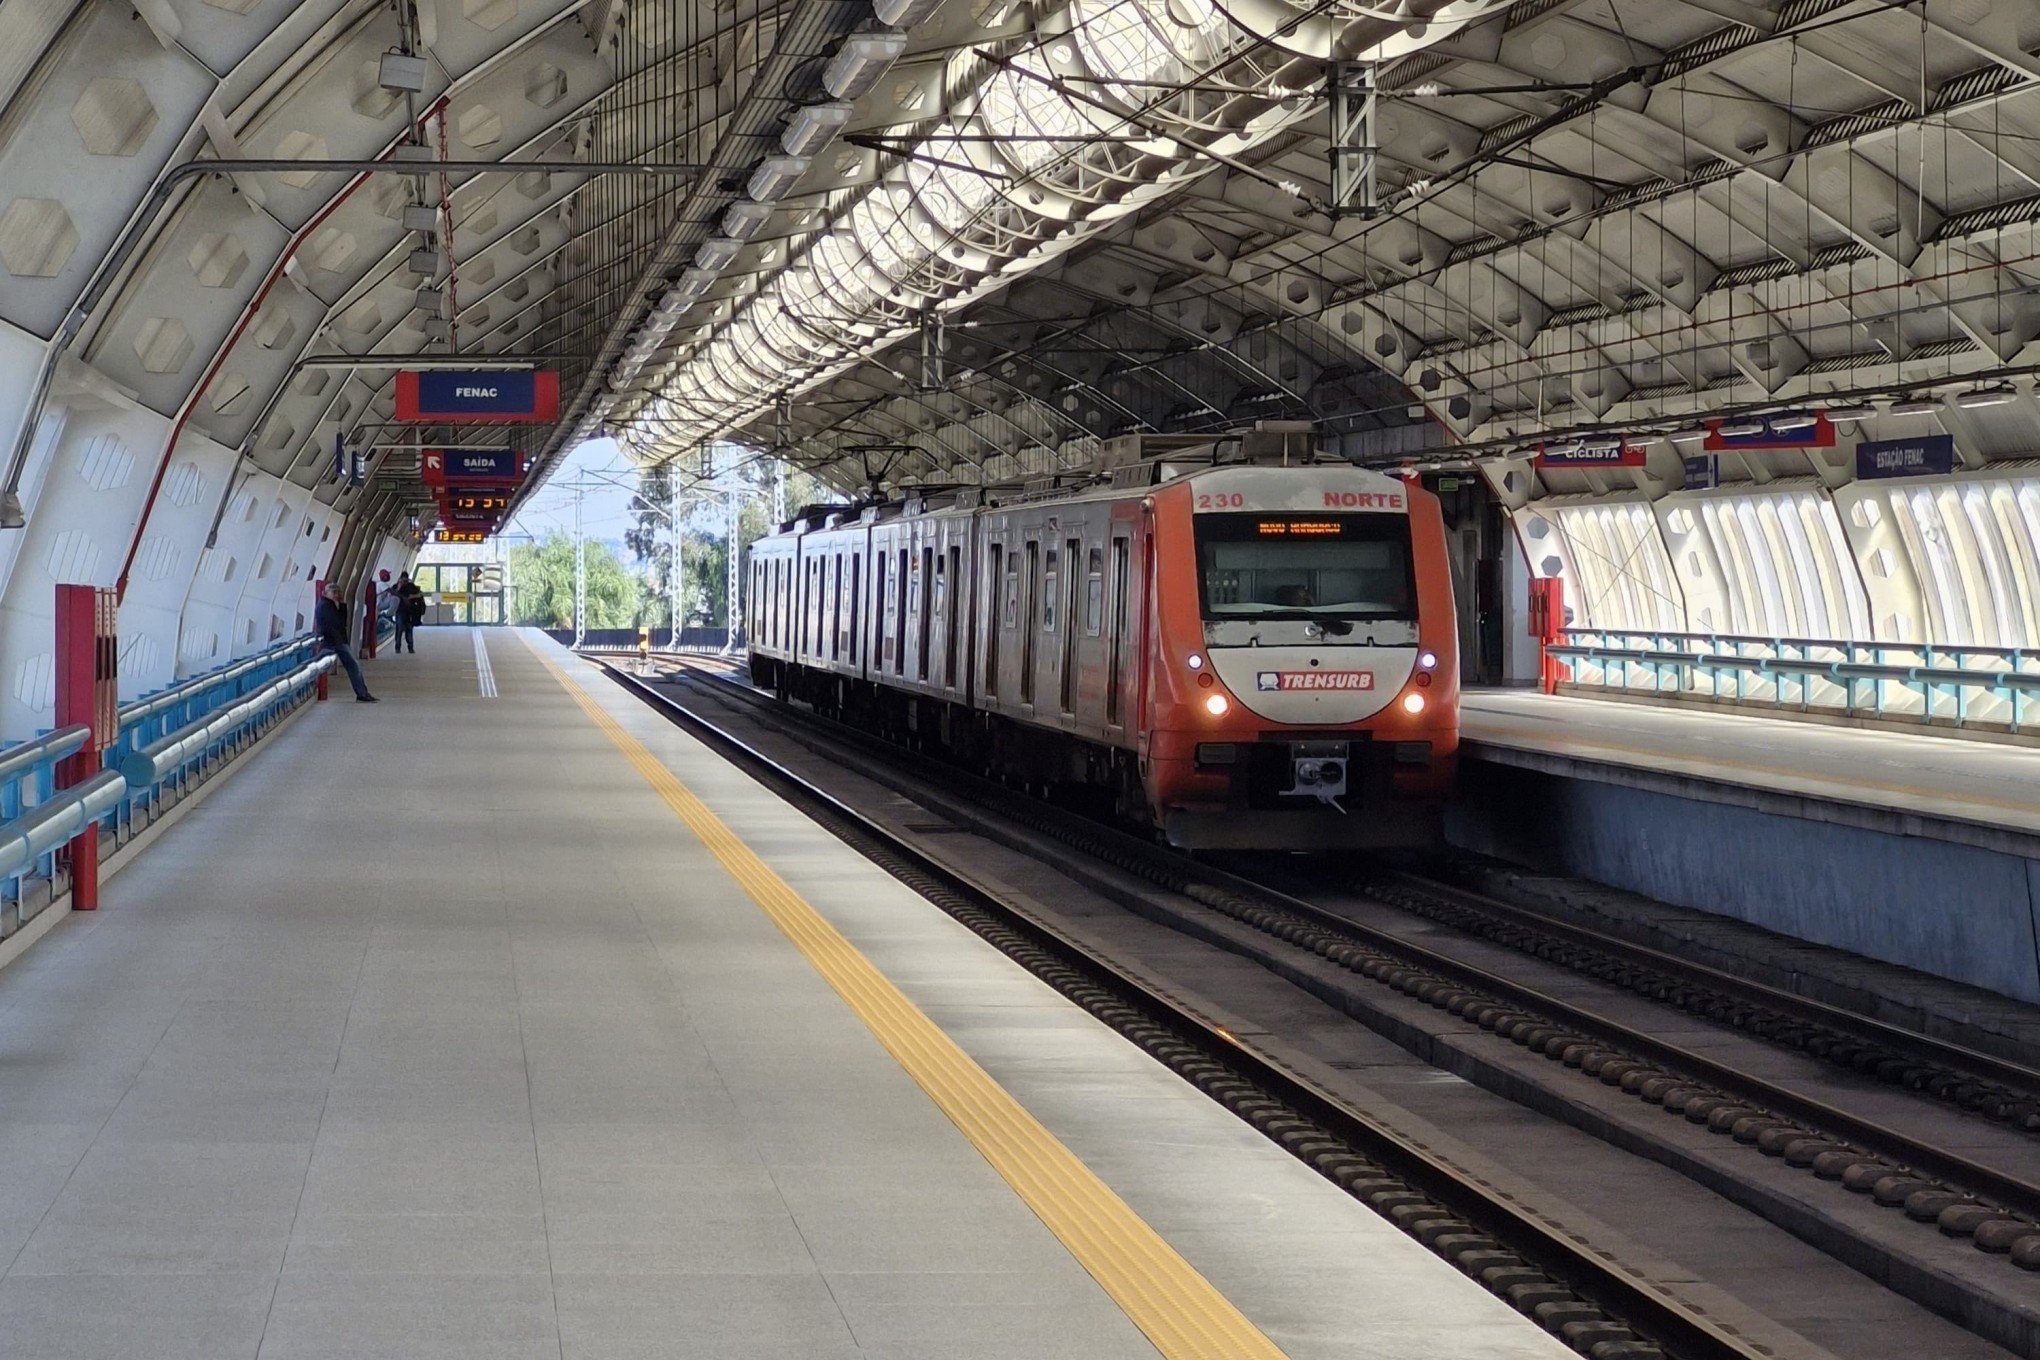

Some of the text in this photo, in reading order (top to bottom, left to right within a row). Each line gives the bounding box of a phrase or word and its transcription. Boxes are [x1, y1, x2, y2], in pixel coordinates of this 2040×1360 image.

[455, 387, 498, 398] FENAC
[463, 456, 496, 467] SAÍDA
[1198, 493, 1244, 509] 230
[1323, 492, 1402, 509] NORTE
[1283, 673, 1372, 689] TRENSURB
